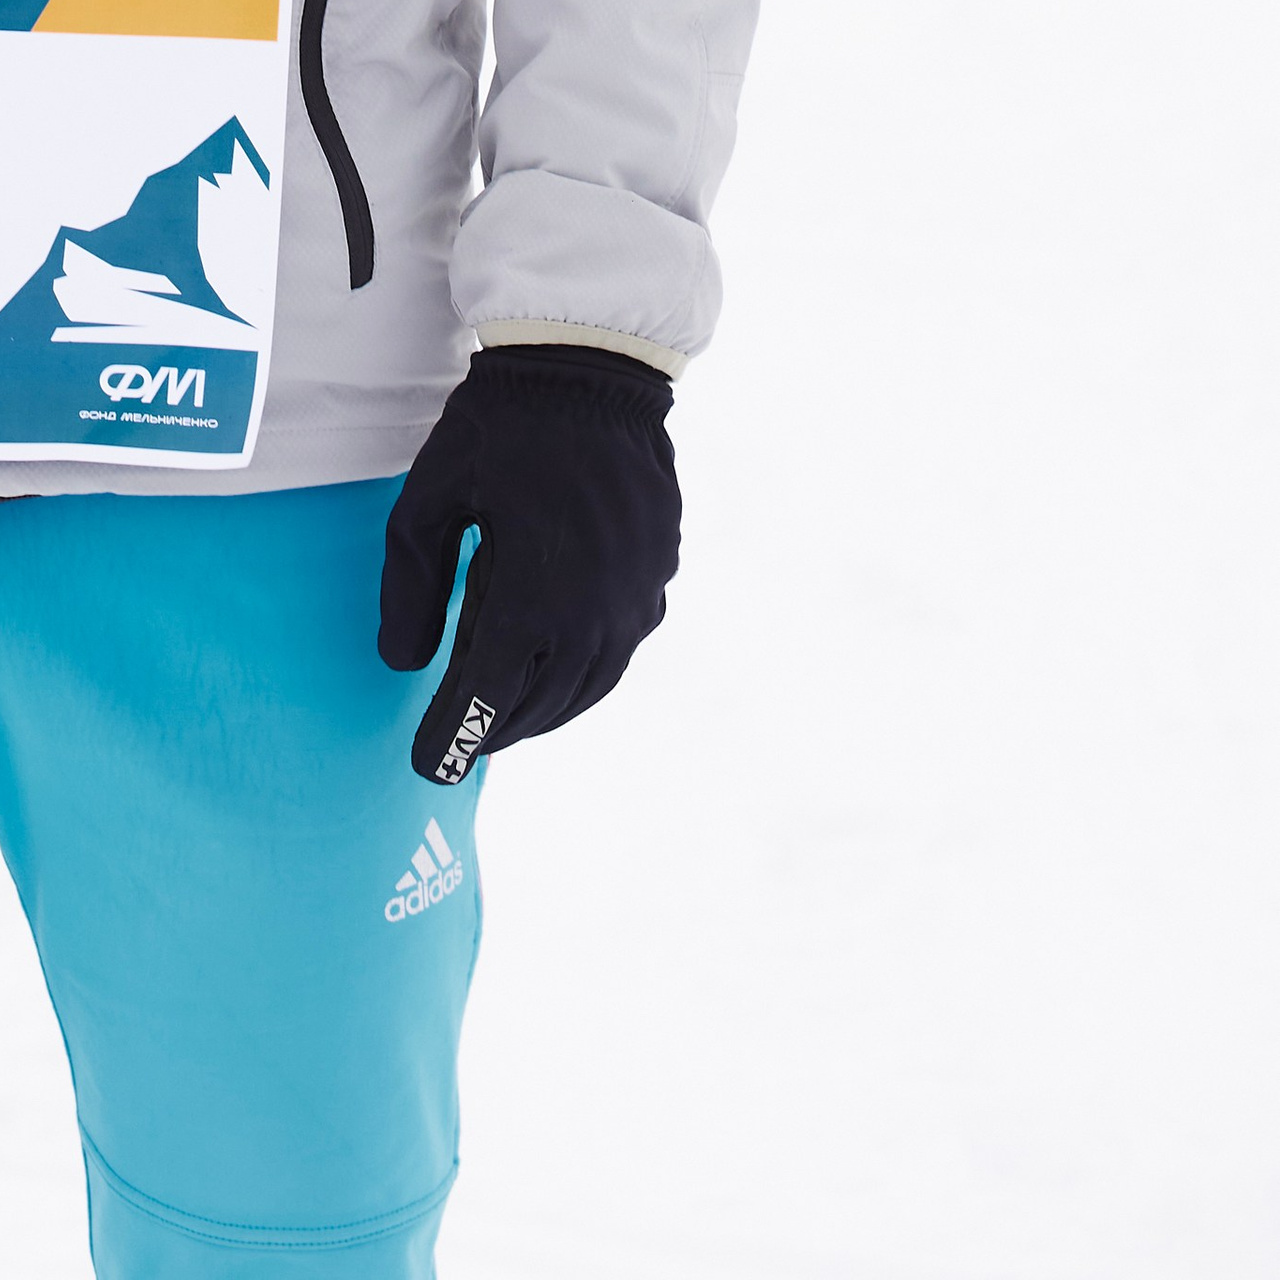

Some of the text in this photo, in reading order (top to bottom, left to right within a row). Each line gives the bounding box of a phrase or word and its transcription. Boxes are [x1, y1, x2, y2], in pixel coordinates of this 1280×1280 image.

[78, 409, 219, 429] ФОНД МЕЛЬНИЧЕНКО
[384, 859, 463, 923] adidas
